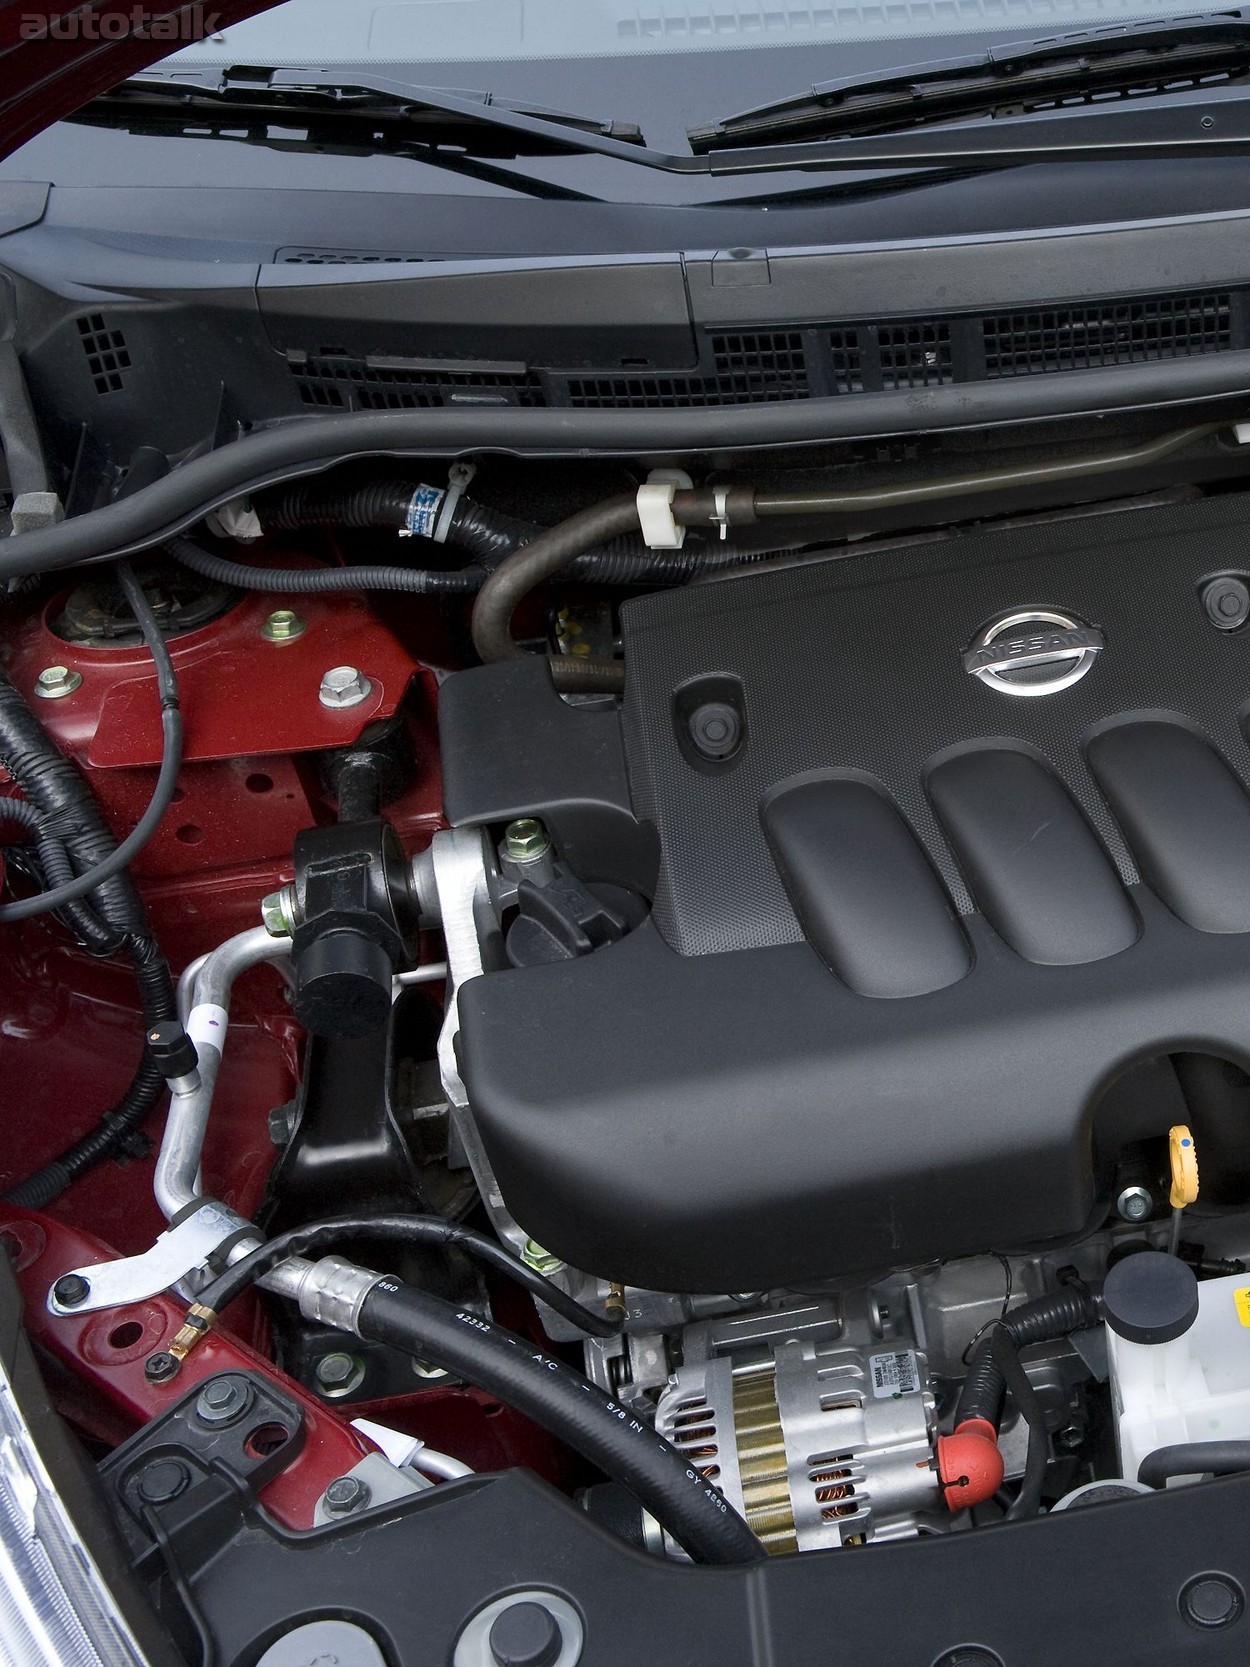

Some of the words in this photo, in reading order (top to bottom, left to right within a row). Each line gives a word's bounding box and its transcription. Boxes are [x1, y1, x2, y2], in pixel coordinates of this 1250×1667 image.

[972, 631, 1092, 665] NISSAN
[455, 1312, 491, 1332] 42332
[606, 1401, 626, 1419] 5/8
[629, 1420, 644, 1433] IN
[685, 1469, 702, 1484] GY
